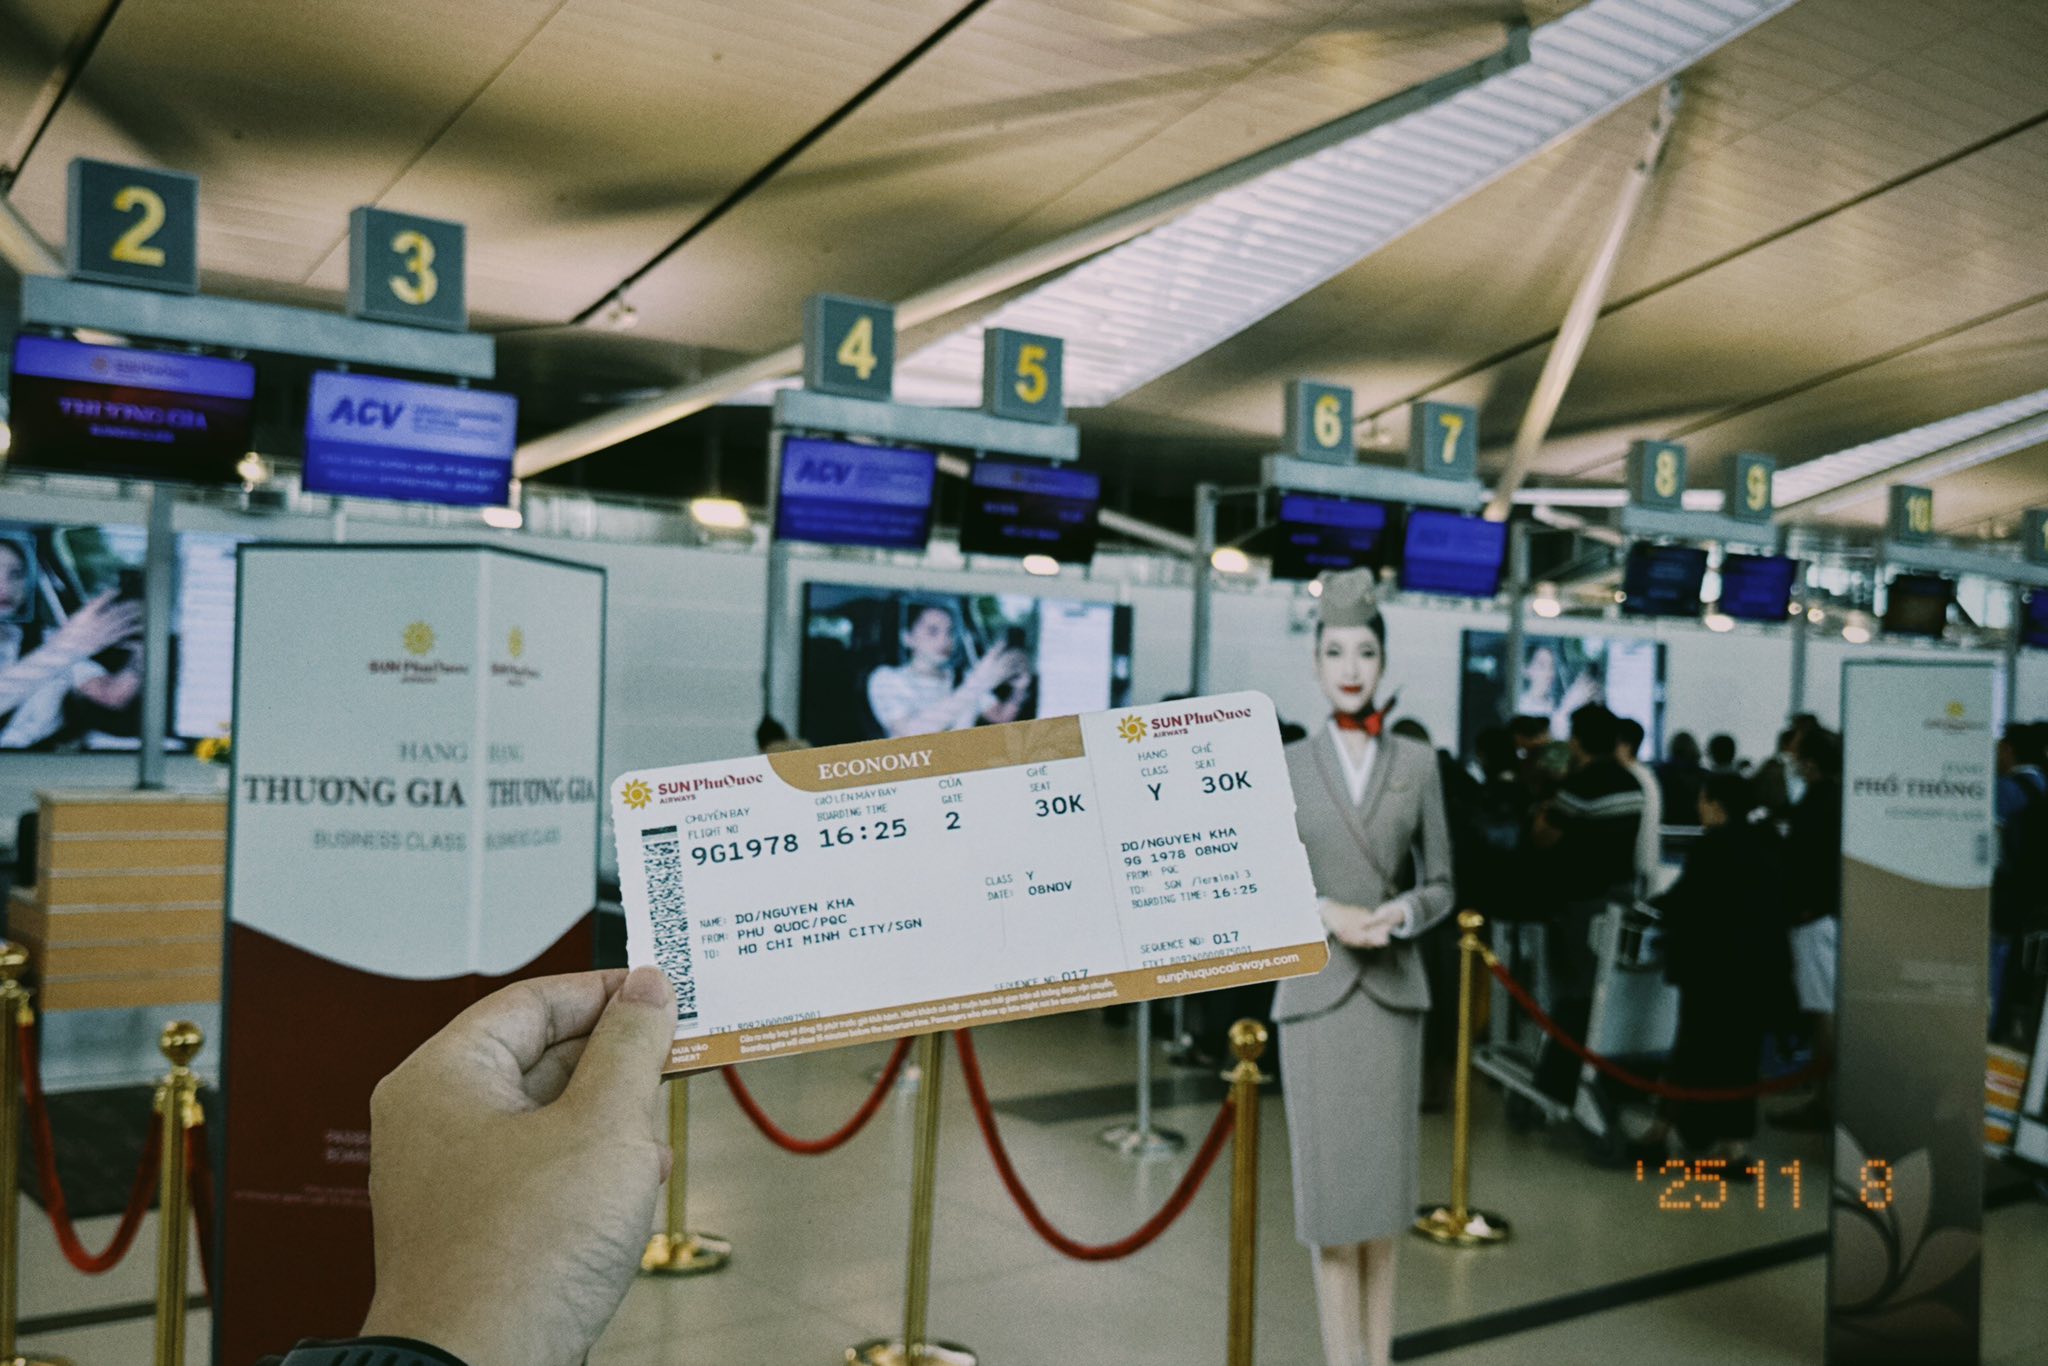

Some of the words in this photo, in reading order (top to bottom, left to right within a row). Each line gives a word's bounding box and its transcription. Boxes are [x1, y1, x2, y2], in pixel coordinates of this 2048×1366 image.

[111, 186, 166, 267] 2
[389, 230, 438, 305] 3
[837, 316, 877, 380] 4
[1015, 343, 1048, 404] 5
[330, 396, 404, 429] ACV
[1313, 395, 1342, 448] 6
[1439, 414, 1464, 464] 7
[1655, 450, 1678, 497] 8
[1746, 464, 1767, 511] 9
[1906, 496, 1932, 533] 10
[1151, 715, 1182, 730] SUN
[1184, 708, 1252, 725] PhuQuoc
[1153, 728, 1188, 738] AIRWAYS
[817, 749, 933, 780] ECONOMY
[1141, 765, 1168, 777] CLASS
[1195, 759, 1216, 770] SEAT
[405, 777, 467, 808] GIA
[658, 781, 691, 796] SUN
[693, 773, 764, 792] PhuQuoc
[878, 787, 897, 798] BAY
[1030, 781, 1050, 792] SEAT
[1147, 783, 1161, 800] Y
[1202, 770, 1252, 794] 30K
[659, 794, 696, 804] AIRWAYS
[941, 793, 963, 804] GATE
[1035, 794, 1085, 817] 30K
[730, 807, 750, 819] BAY
[817, 809, 862, 821] BOARDING
[867, 804, 888, 815] TIME
[945, 811, 960, 830] 2
[312, 829, 402, 850] BUSINESS
[406, 831, 467, 851] CLASS
[688, 827, 720, 840] FLIGHT
[727, 825, 739, 835] NO
[819, 819, 907, 848] 16:25
[1121, 832, 1201, 852] DO/NGUYEN
[1209, 827, 1237, 840] KHA
[691, 833, 799, 866] 9G1978
[1124, 855, 1141, 867] 9G
[1151, 849, 1186, 863] 1978
[1195, 842, 1238, 857] 08NOV
[985, 874, 1013, 886] CLASS
[1026, 871, 1034, 881] Y
[1161, 865, 1179, 876] PQC
[1164, 880, 1182, 890] SGN
[1245, 869, 1252, 878] 3
[1028, 881, 1072, 895] 08NOV
[1132, 895, 1176, 909] BOARDING
[1213, 883, 1258, 900] 16:25
[735, 902, 818, 924] DO/NGUYEN
[826, 898, 855, 910] KHA
[737, 927, 764, 940] PHU
[774, 914, 848, 932] QUOC/PQC
[738, 943, 758, 955] HO
[766, 937, 793, 950] CHI
[803, 930, 840, 945] MINH
[849, 918, 923, 938] CITY/SGN
[1140, 938, 1184, 954] SEQUENCE
[1212, 930, 1239, 945] 017
[1062, 968, 1089, 982] 017
[1156, 952, 1300, 984] sunphuquocairways.com
